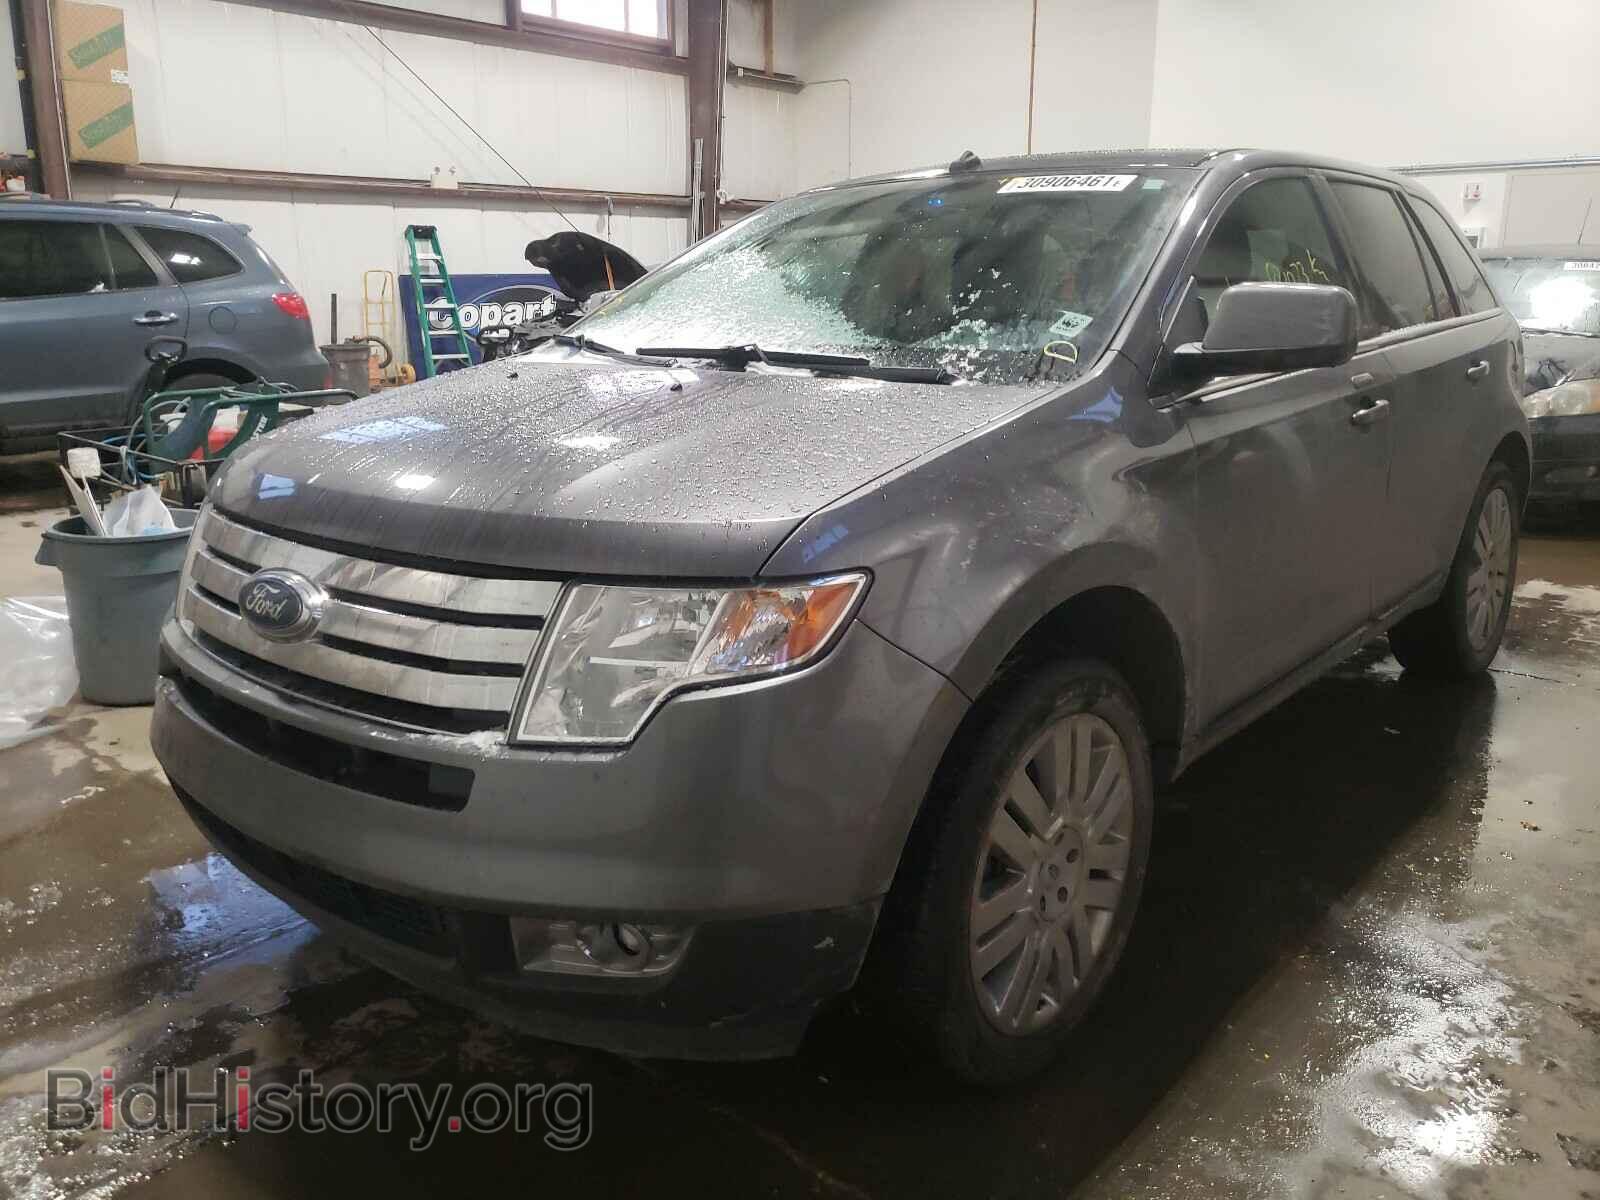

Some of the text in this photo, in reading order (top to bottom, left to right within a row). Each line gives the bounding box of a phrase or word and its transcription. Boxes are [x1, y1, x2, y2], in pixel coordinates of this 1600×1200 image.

[1018, 175, 1114, 189] 30906461
[427, 293, 556, 330] Copart
[246, 582, 289, 618] Ford
